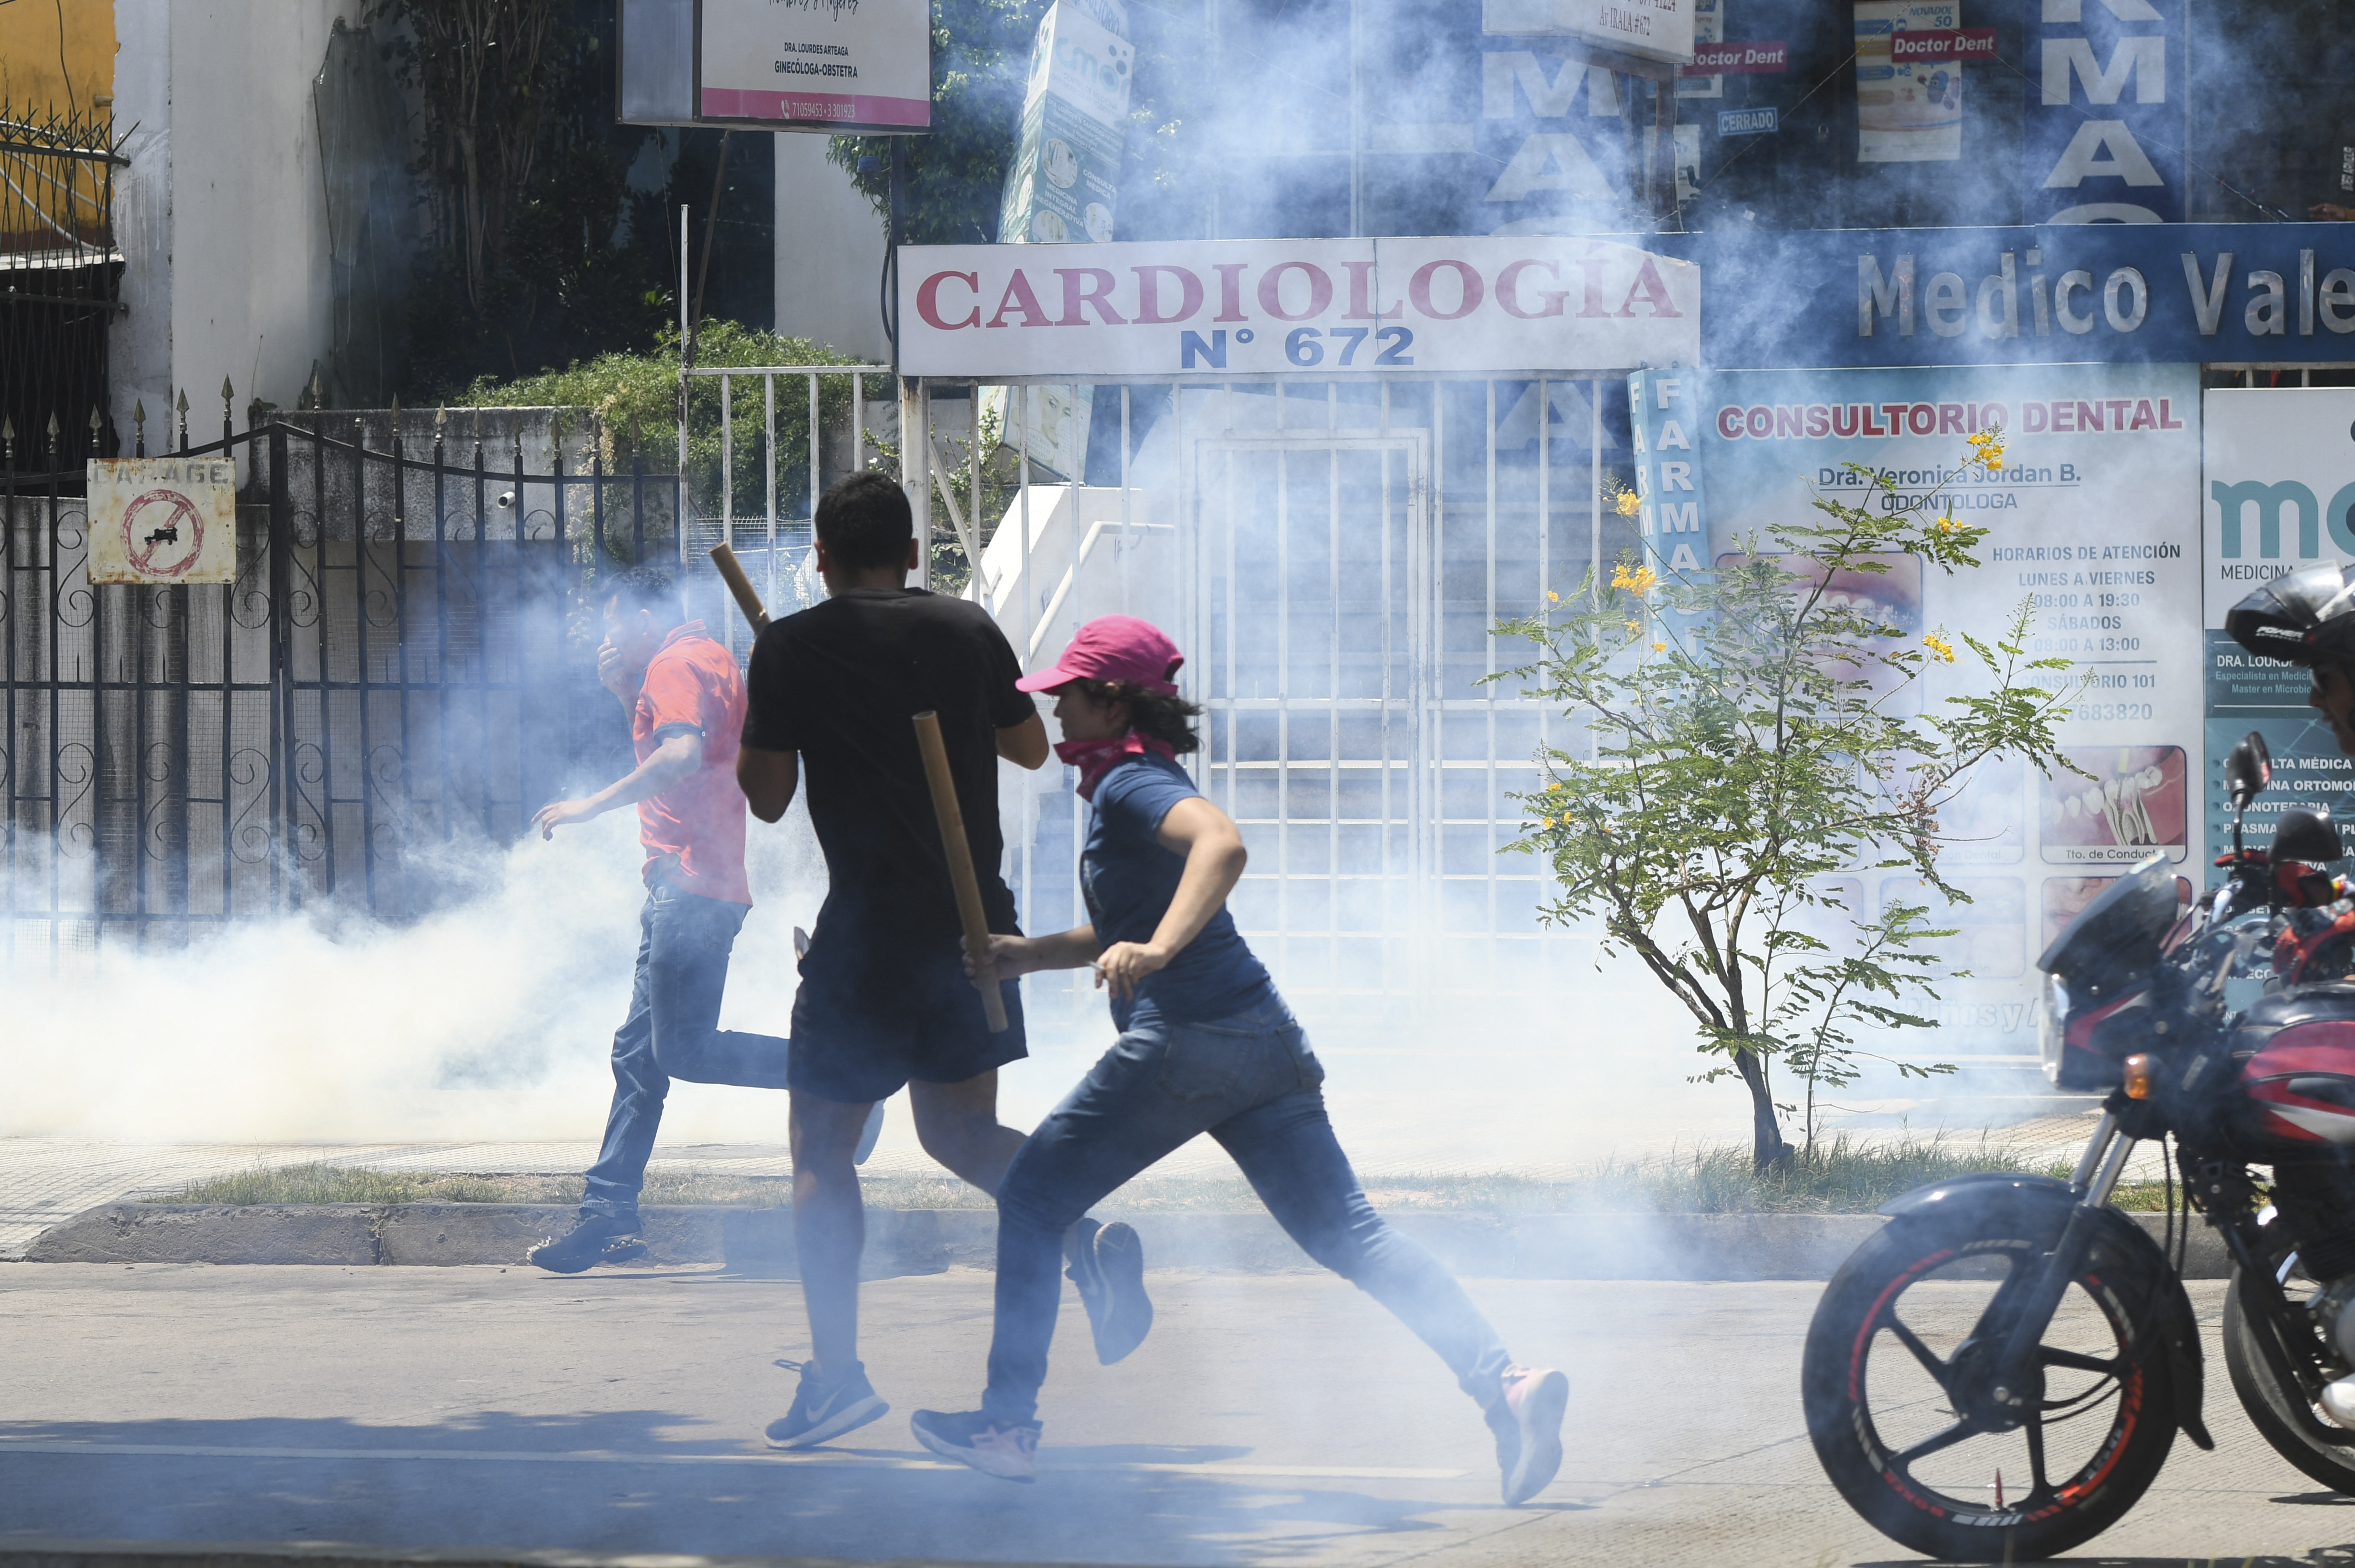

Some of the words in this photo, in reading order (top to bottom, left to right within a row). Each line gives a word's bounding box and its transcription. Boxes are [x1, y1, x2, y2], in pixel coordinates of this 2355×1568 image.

[1610, 7, 1633, 32] IRALA
[1634, 13, 1650, 36] #672
[1935, 16, 1952, 27] 50
[784, 42, 797, 53] DRA.
[798, 43, 823, 55] LOURDES
[824, 45, 848, 56] ARTEAGA
[1894, 38, 1951, 54] Doctor
[1955, 36, 1994, 51] Dent
[1686, 52, 1742, 66] octor
[1745, 50, 1783, 64] Dent
[775, 58, 858, 78] GINECÓLOGA-OBSTETRA
[793, 103, 822, 117] 71059453
[828, 104, 831, 117] 3
[833, 104, 855, 118] 301923
[1722, 112, 1773, 131] CERRADO
[1083, 169, 1116, 193] CONSULTA
[1045, 190, 1077, 214] INTEGRAL
[1046, 182, 1077, 206] MEDICINA
[1035, 194, 1084, 229] REGENERATIVA
[915, 246, 1683, 331] CARDIOLOGÍA
[1858, 249, 2148, 338] Medico
[2181, 249, 2355, 336] Vale
[1284, 326, 1414, 367] 672
[1717, 402, 2008, 438] CONSULTORIO
[2023, 399, 2182, 433] DENTAL
[1819, 468, 1863, 486] Dra.
[1870, 464, 1964, 485] Veronica
[1974, 464, 2052, 484] Jordan
[2060, 464, 2081, 481] B.
[1881, 493, 2017, 511] ODONTOLOGA
[1993, 547, 2072, 561] HORARIOS
[2078, 546, 2097, 559] DE
[2102, 542, 2181, 559] ATENCIÓN
[2019, 572, 2068, 586] LUNES
[2074, 573, 2083, 585] A
[2089, 571, 2155, 585] VIERNES
[2034, 594, 2078, 607] 08:00
[2083, 594, 2093, 607] A
[2098, 593, 2140, 606] 19:30
[2048, 614, 2122, 630] SÁBADOS
[2034, 638, 2078, 652] 08:00
[2083, 638, 2093, 651] A
[2099, 637, 2140, 651] 13:00
[2217, 655, 2245, 667] DRA.
[2132, 674, 2155, 688] 101
[2216, 671, 2266, 682] Especialista
[2232, 685, 2260, 694] Master
[2299, 756, 2353, 769] MÉDICA
[2293, 780, 2355, 791] ORTOMO
[1965, 849, 2001, 859] Dental
[2067, 849, 2085, 859] Tto.
[2089, 849, 2103, 859] de
[2001, 1002, 2024, 1034] y
